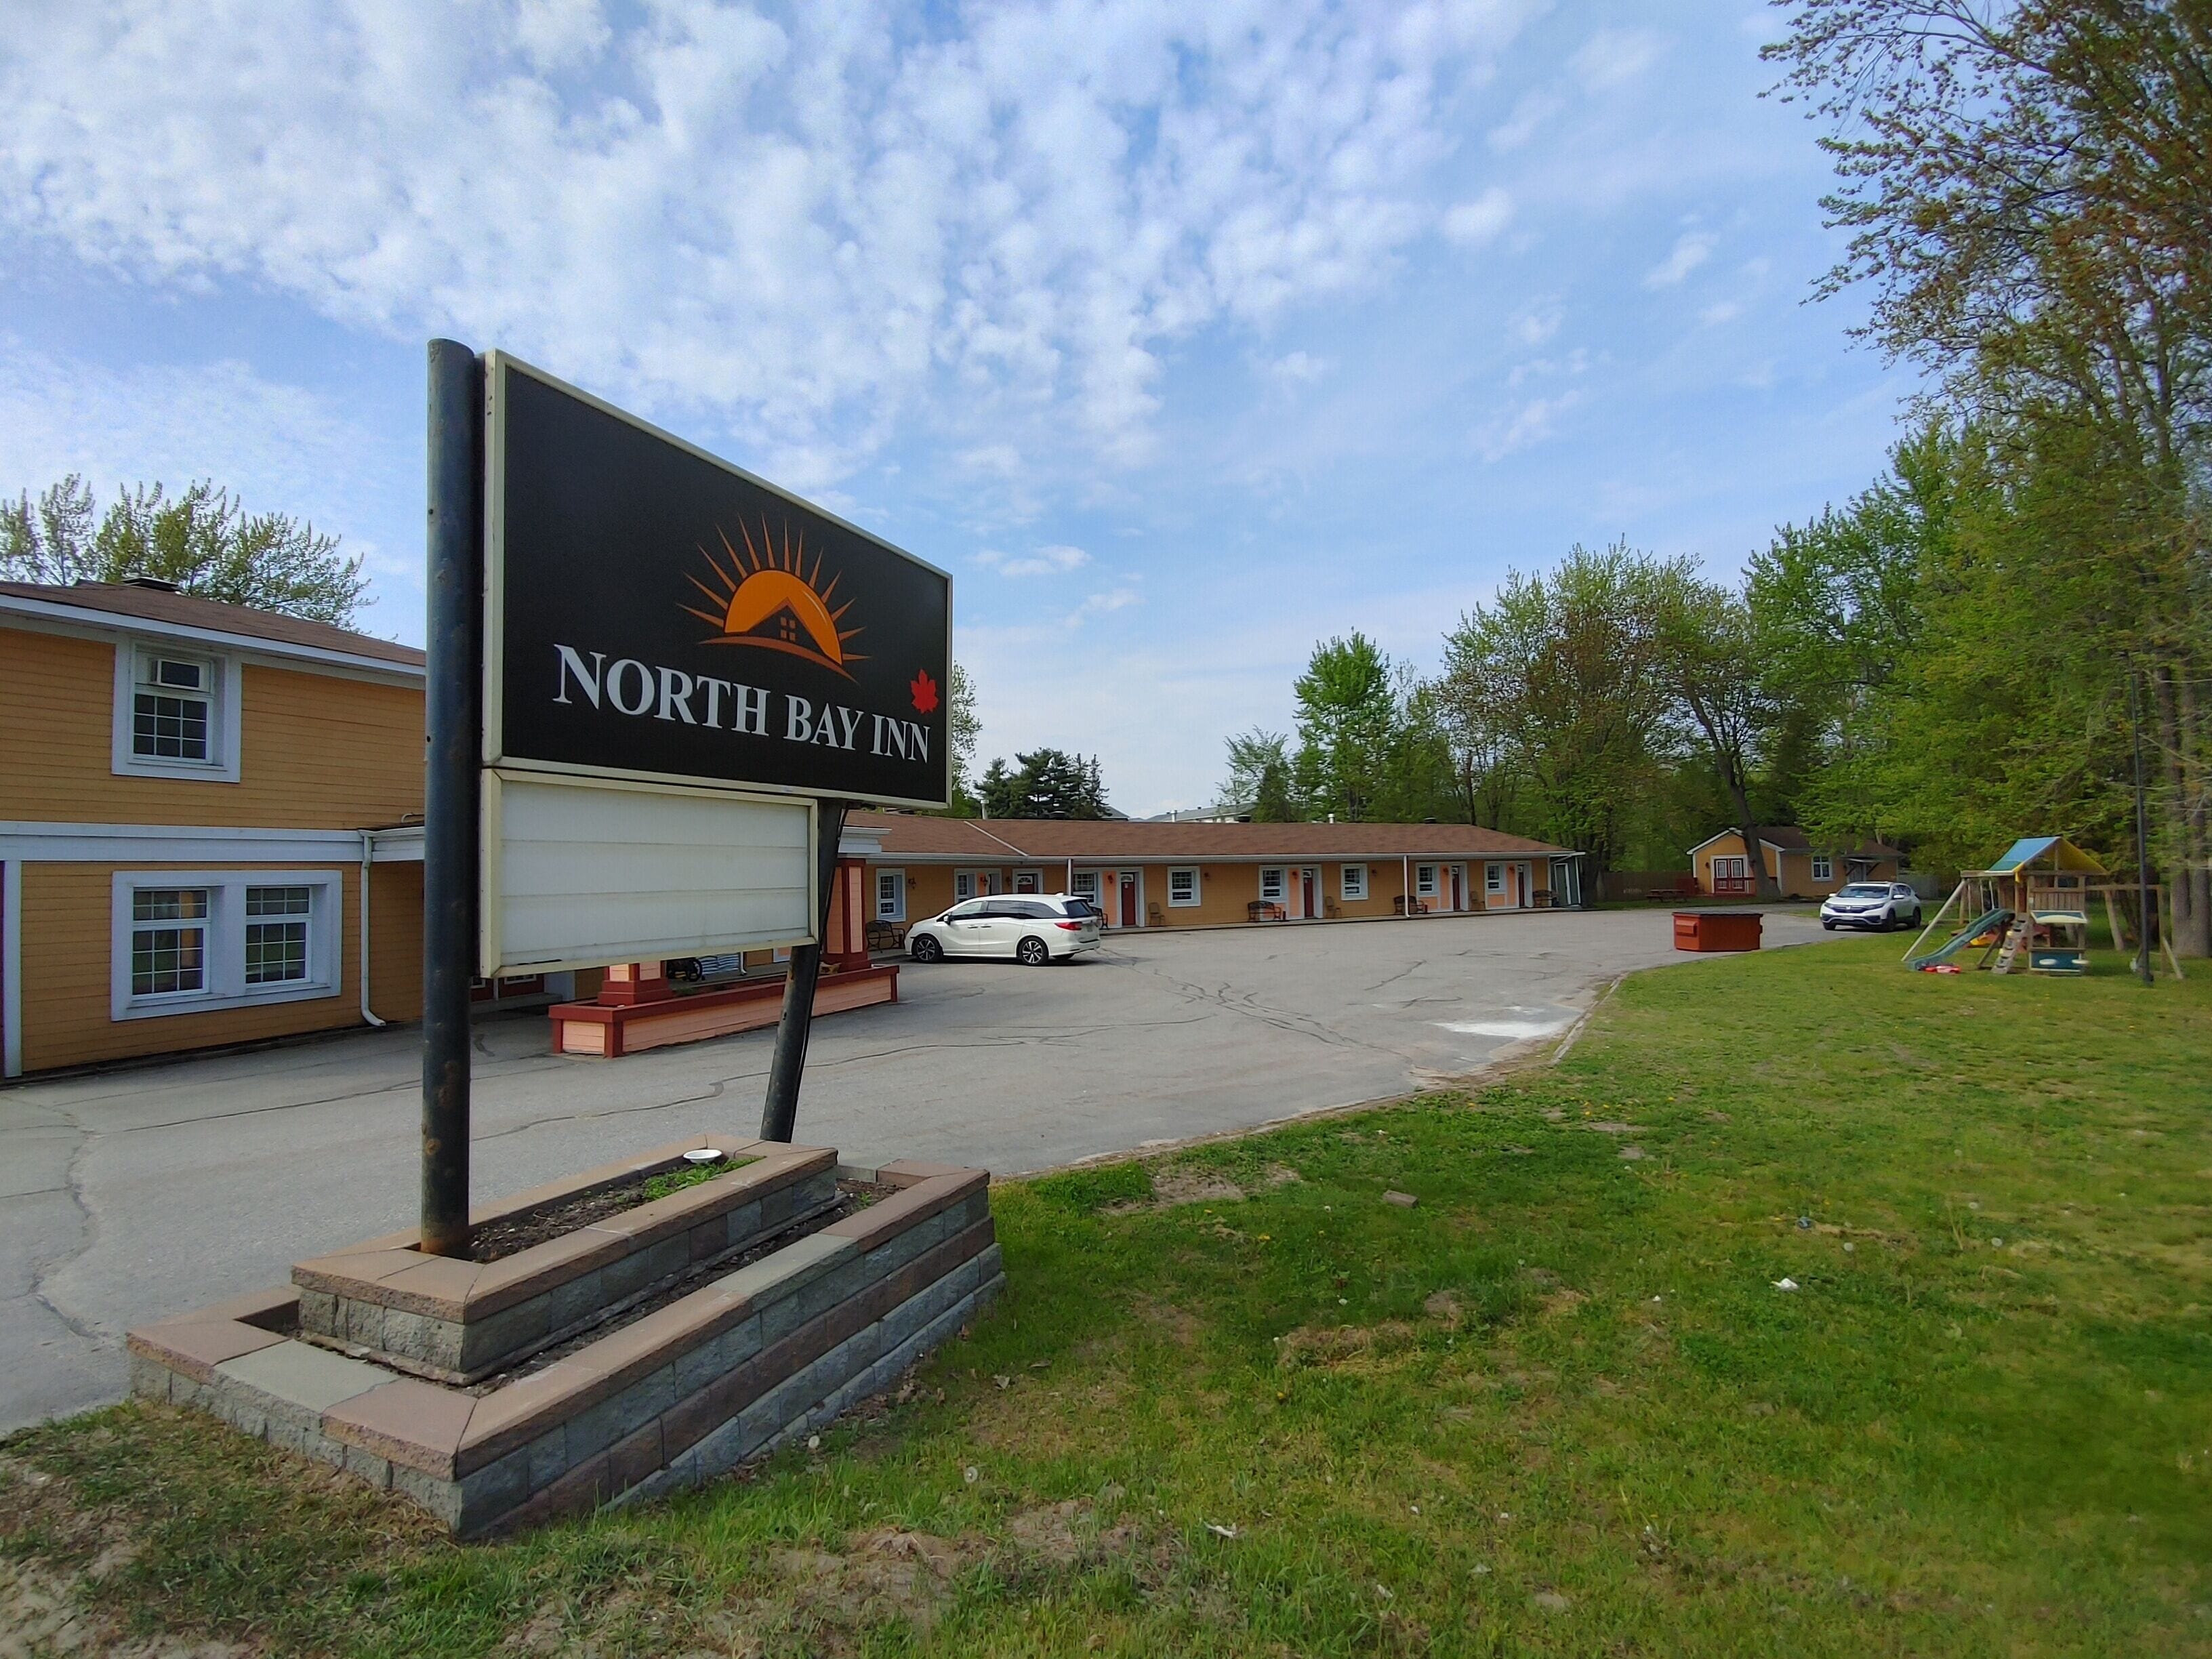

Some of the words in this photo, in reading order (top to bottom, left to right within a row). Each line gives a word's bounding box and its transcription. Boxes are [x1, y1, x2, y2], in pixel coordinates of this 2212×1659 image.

[552, 644, 771, 737] NORTH
[783, 695, 864, 750] BAY
[870, 714, 930, 763] INN
